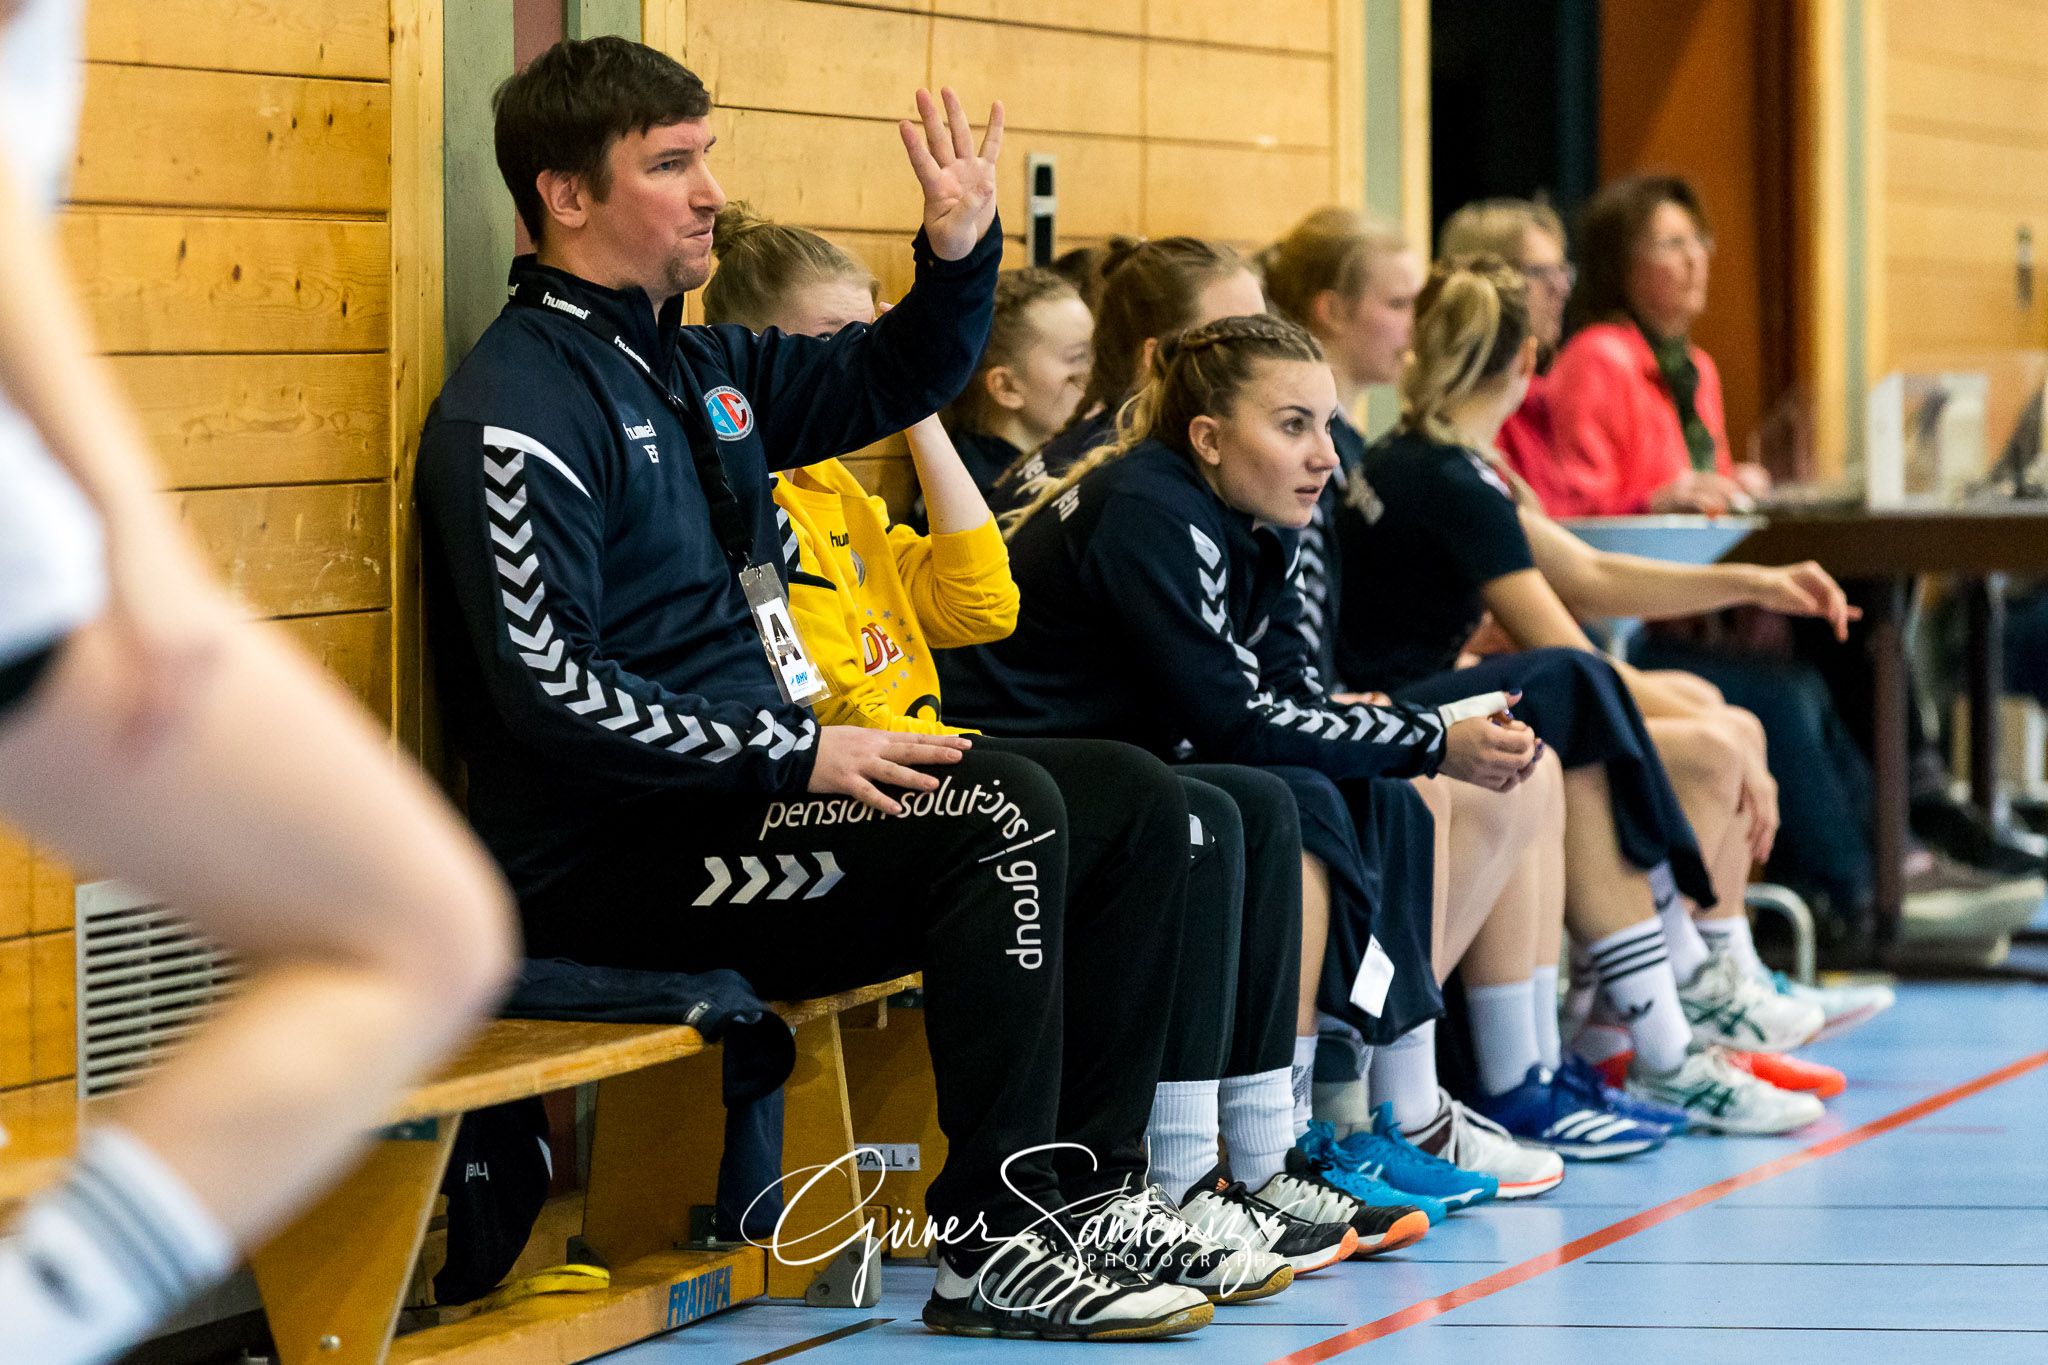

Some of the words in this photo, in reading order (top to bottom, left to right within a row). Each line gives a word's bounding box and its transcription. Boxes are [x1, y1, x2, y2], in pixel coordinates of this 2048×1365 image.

[542, 291, 591, 320] hummel
[622, 418, 657, 441] hummel
[769, 613, 802, 667] A
[996, 860, 1044, 970] group
[667, 1264, 732, 1329] FRATUFA
